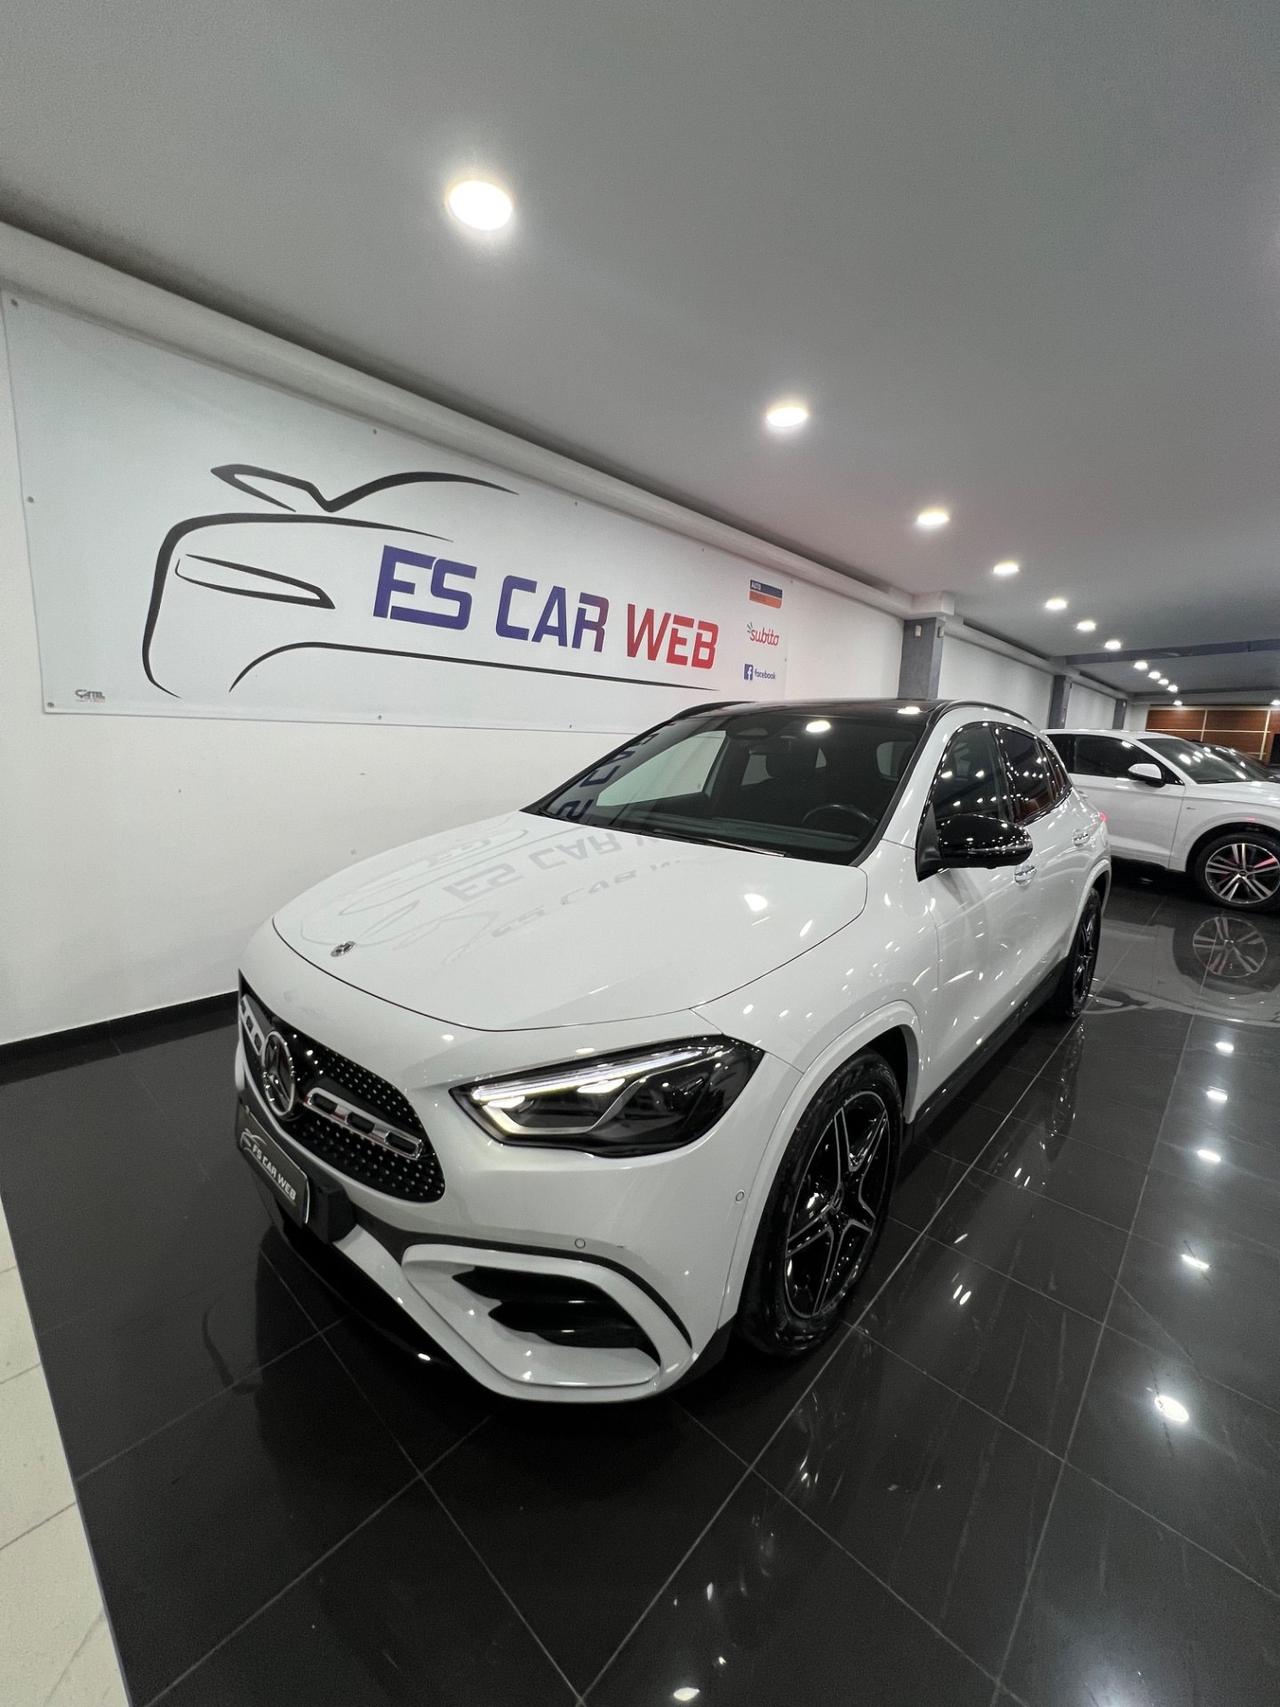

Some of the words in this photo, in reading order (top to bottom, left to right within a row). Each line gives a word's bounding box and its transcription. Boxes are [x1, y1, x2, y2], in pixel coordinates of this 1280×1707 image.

[373, 545, 477, 631] ES
[495, 574, 609, 652] CAR
[626, 602, 719, 670] WEB
[750, 627, 780, 646] subito
[754, 668, 776, 680] facebook
[262, 1156, 277, 1178] CAR
[277, 1172, 297, 1201] WEB
